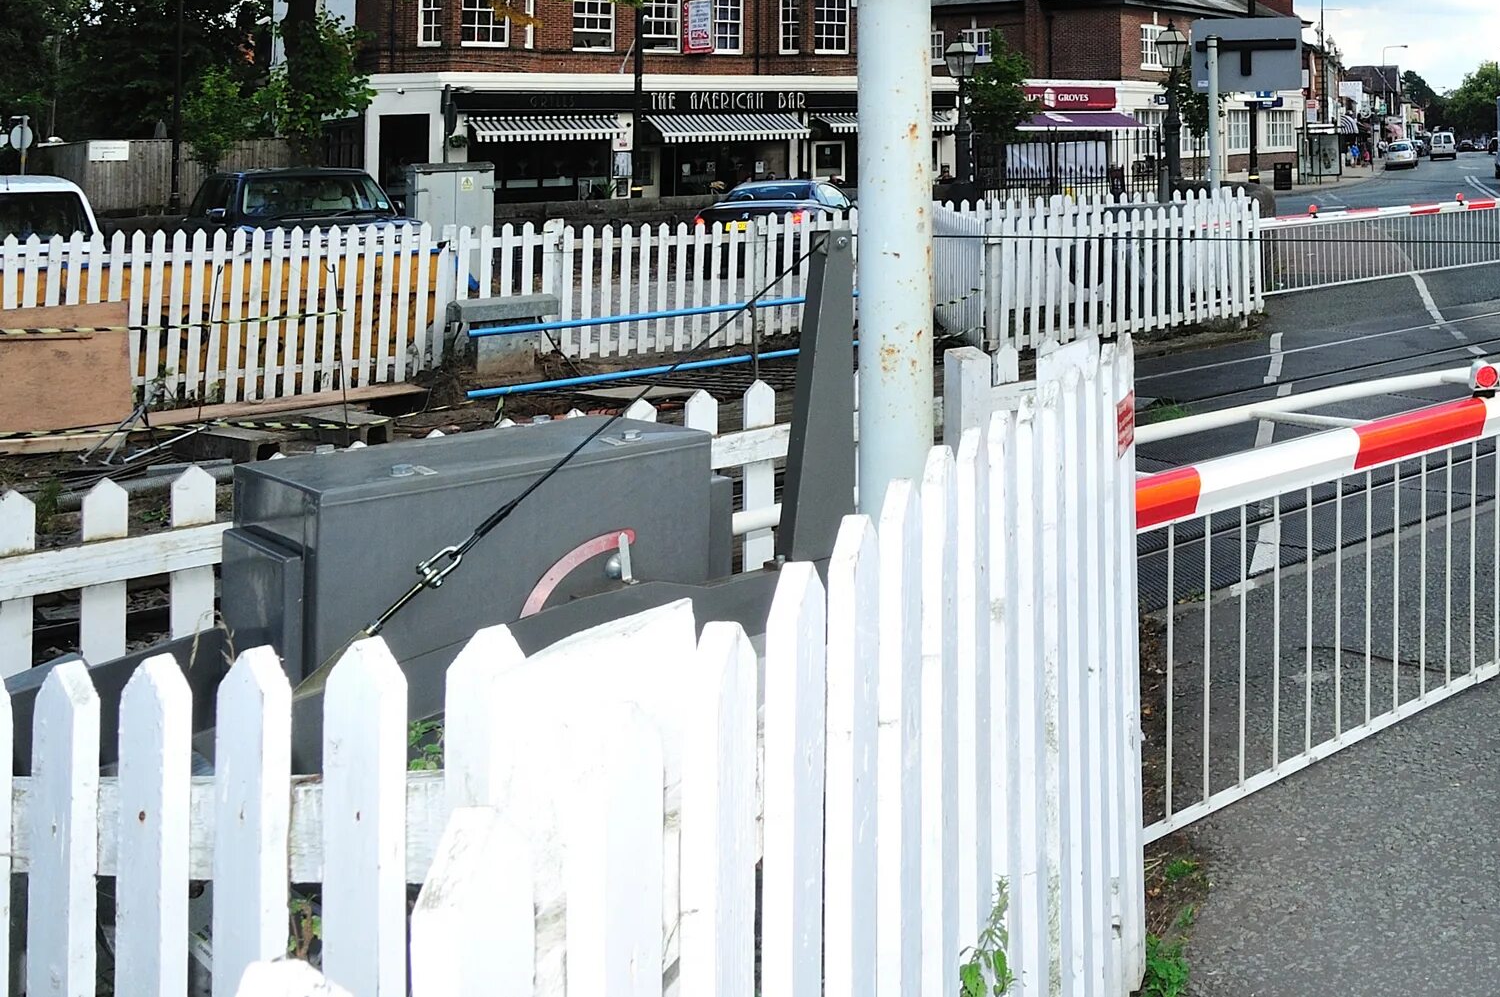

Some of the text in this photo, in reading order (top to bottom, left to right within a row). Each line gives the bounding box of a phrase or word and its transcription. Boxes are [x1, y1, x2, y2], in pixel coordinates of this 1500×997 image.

[651, 92, 806, 110] THE AMERICAN BAR
[1058, 94, 1089, 102] GROVES
